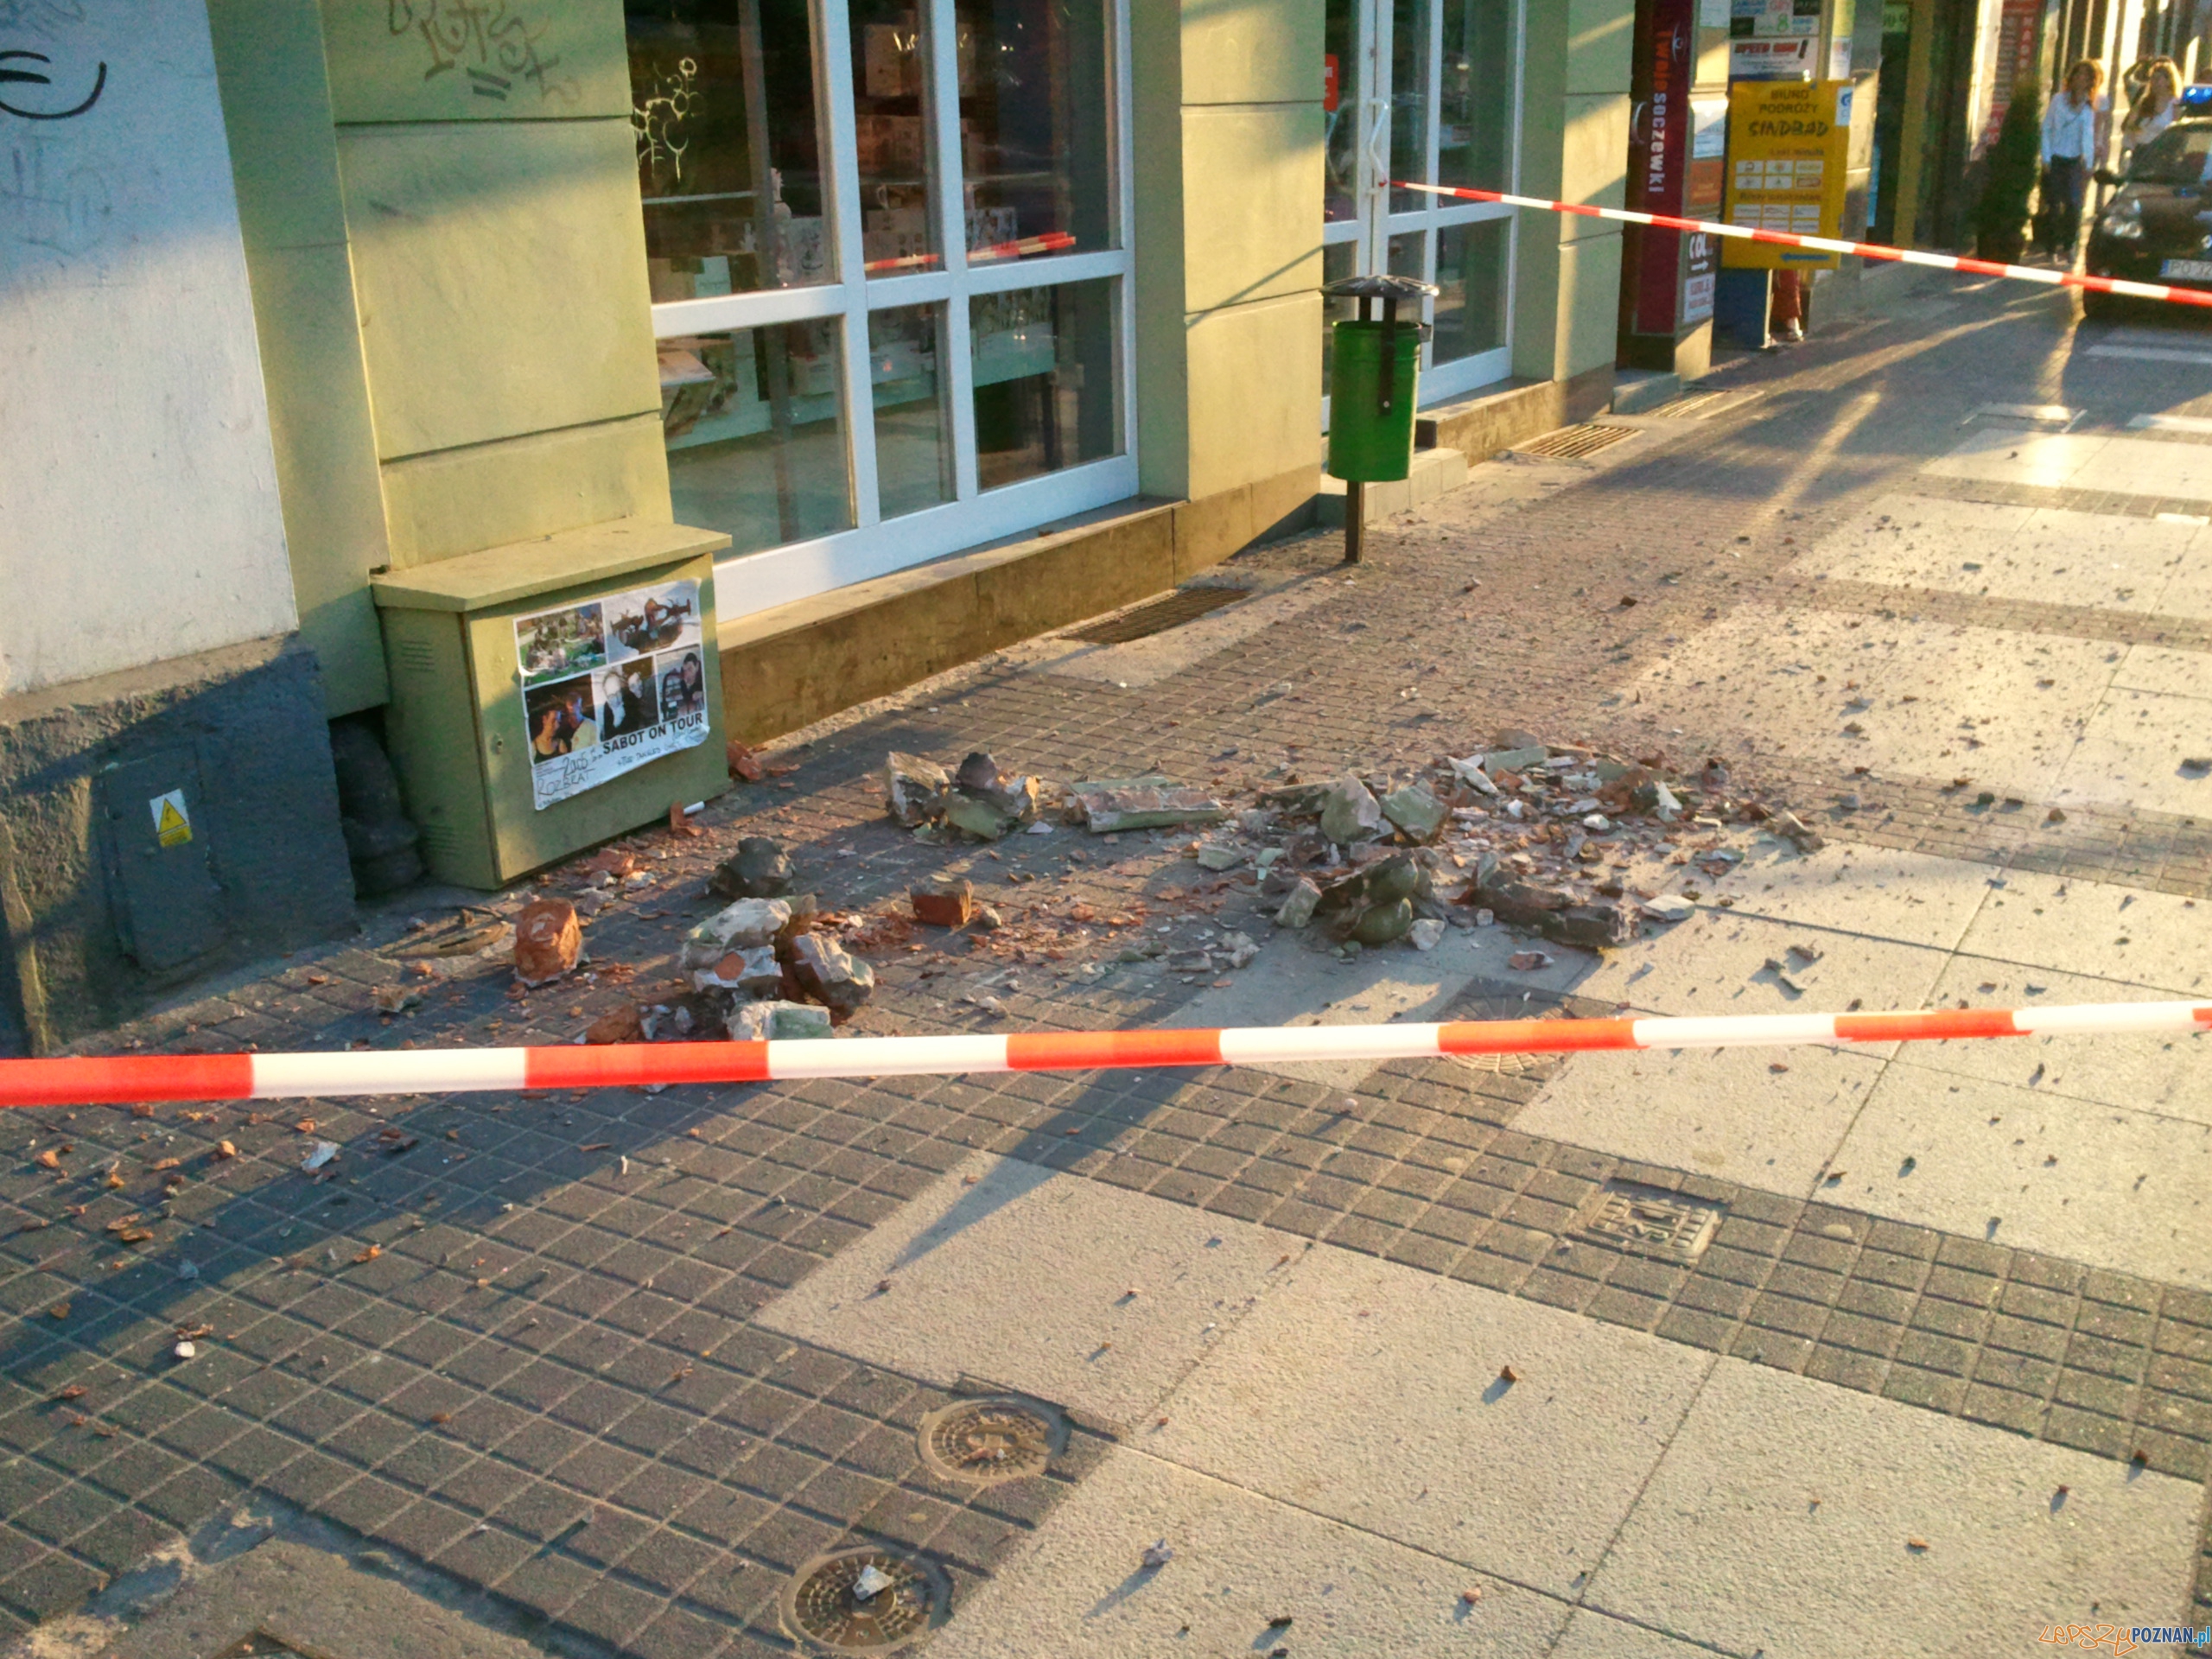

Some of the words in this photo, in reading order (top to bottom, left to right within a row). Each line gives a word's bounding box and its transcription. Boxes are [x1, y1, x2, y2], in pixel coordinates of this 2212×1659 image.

[602, 731, 645, 755] SABOT
[649, 724, 667, 740] ON
[670, 713, 703, 733] TOUR
